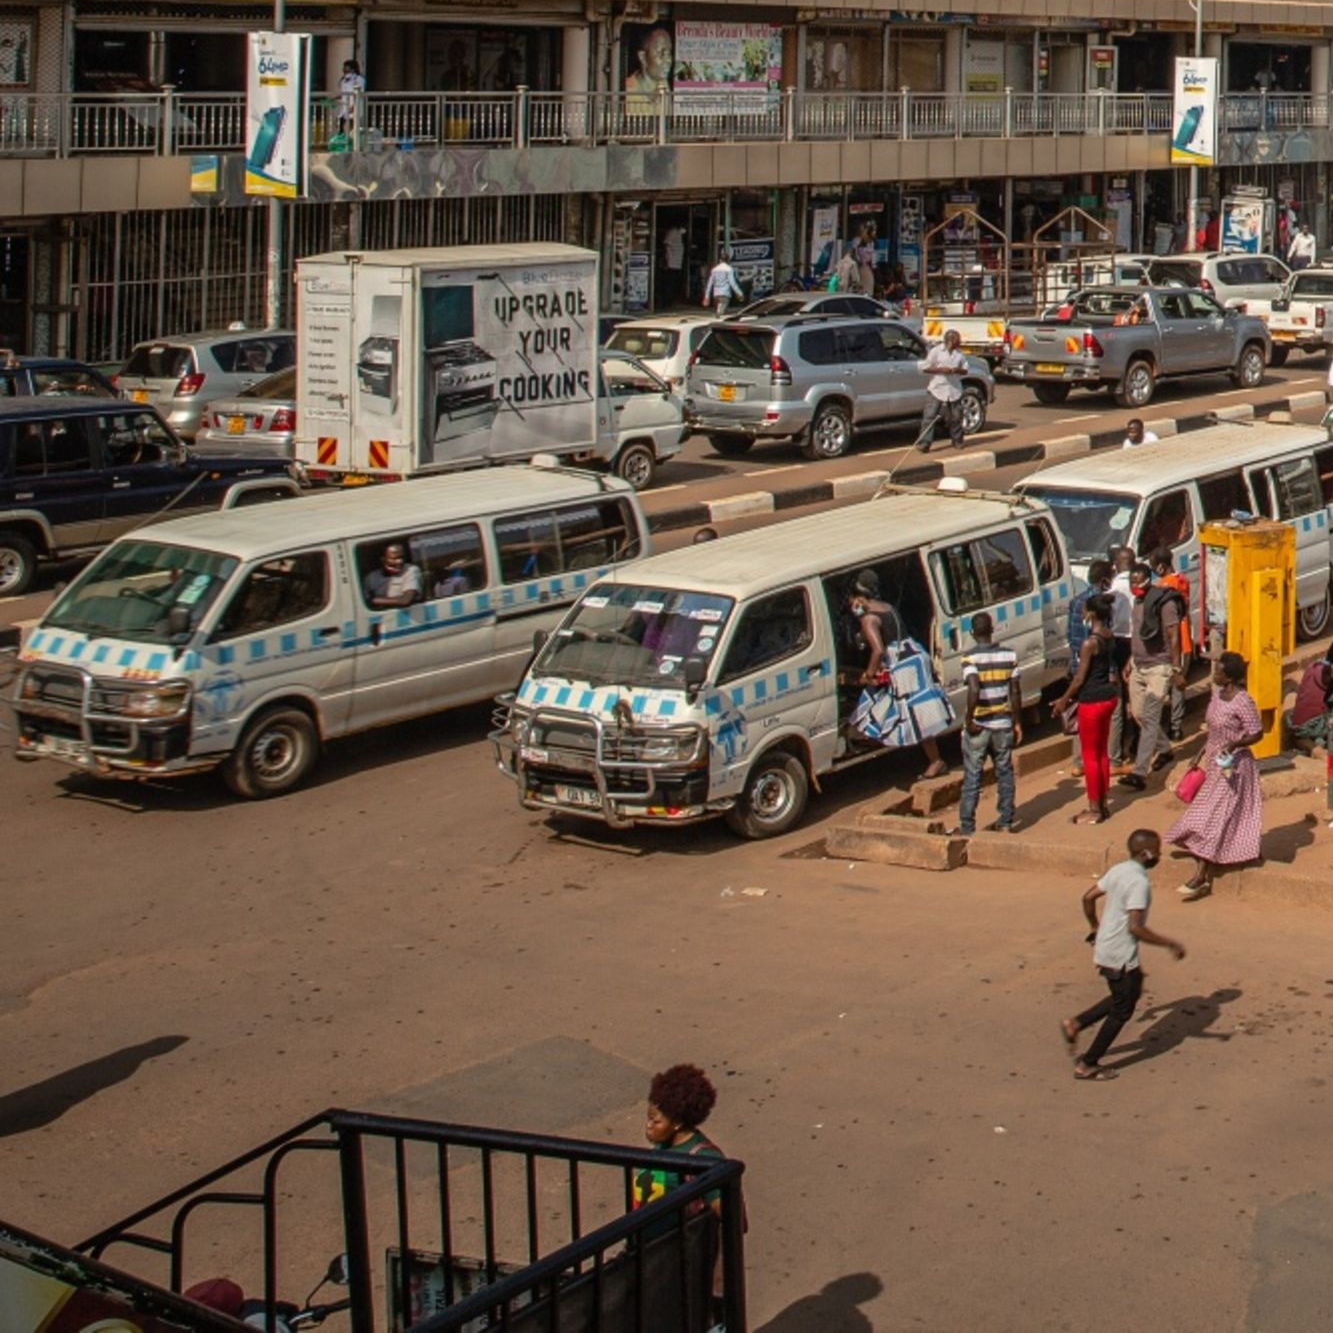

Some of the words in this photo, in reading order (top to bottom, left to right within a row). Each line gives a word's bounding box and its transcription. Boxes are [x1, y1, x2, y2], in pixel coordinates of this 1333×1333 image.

[495, 287, 589, 323] UPGRADE
[519, 327, 571, 356] YOUR
[500, 370, 590, 403] COOKING
